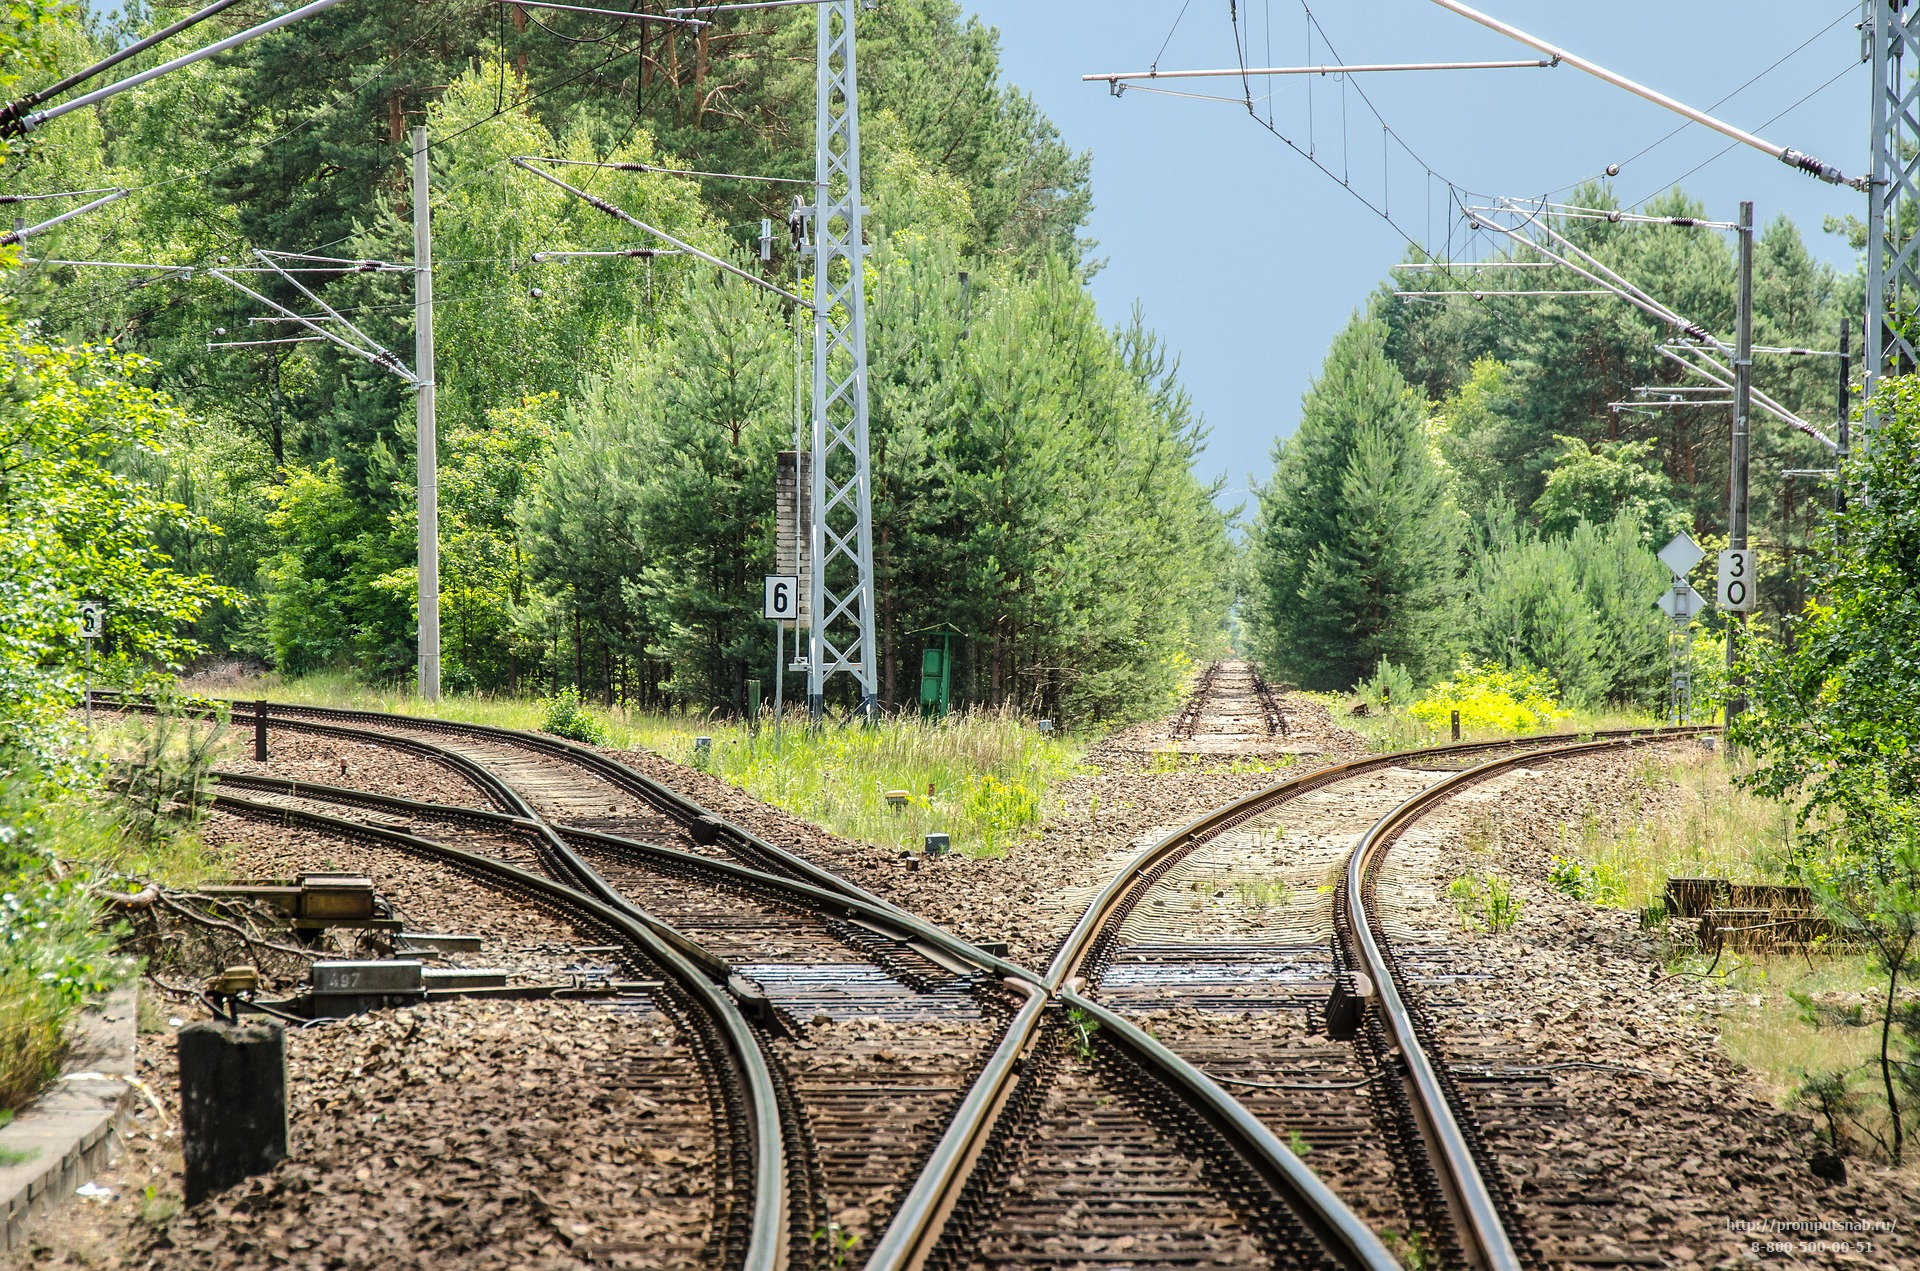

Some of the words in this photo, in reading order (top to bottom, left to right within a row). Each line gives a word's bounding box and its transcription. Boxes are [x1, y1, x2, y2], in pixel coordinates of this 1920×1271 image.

[1730, 553, 1744, 577] 3
[773, 582, 788, 613] 6
[1727, 580, 1746, 605] 0
[329, 971, 360, 988] 497
